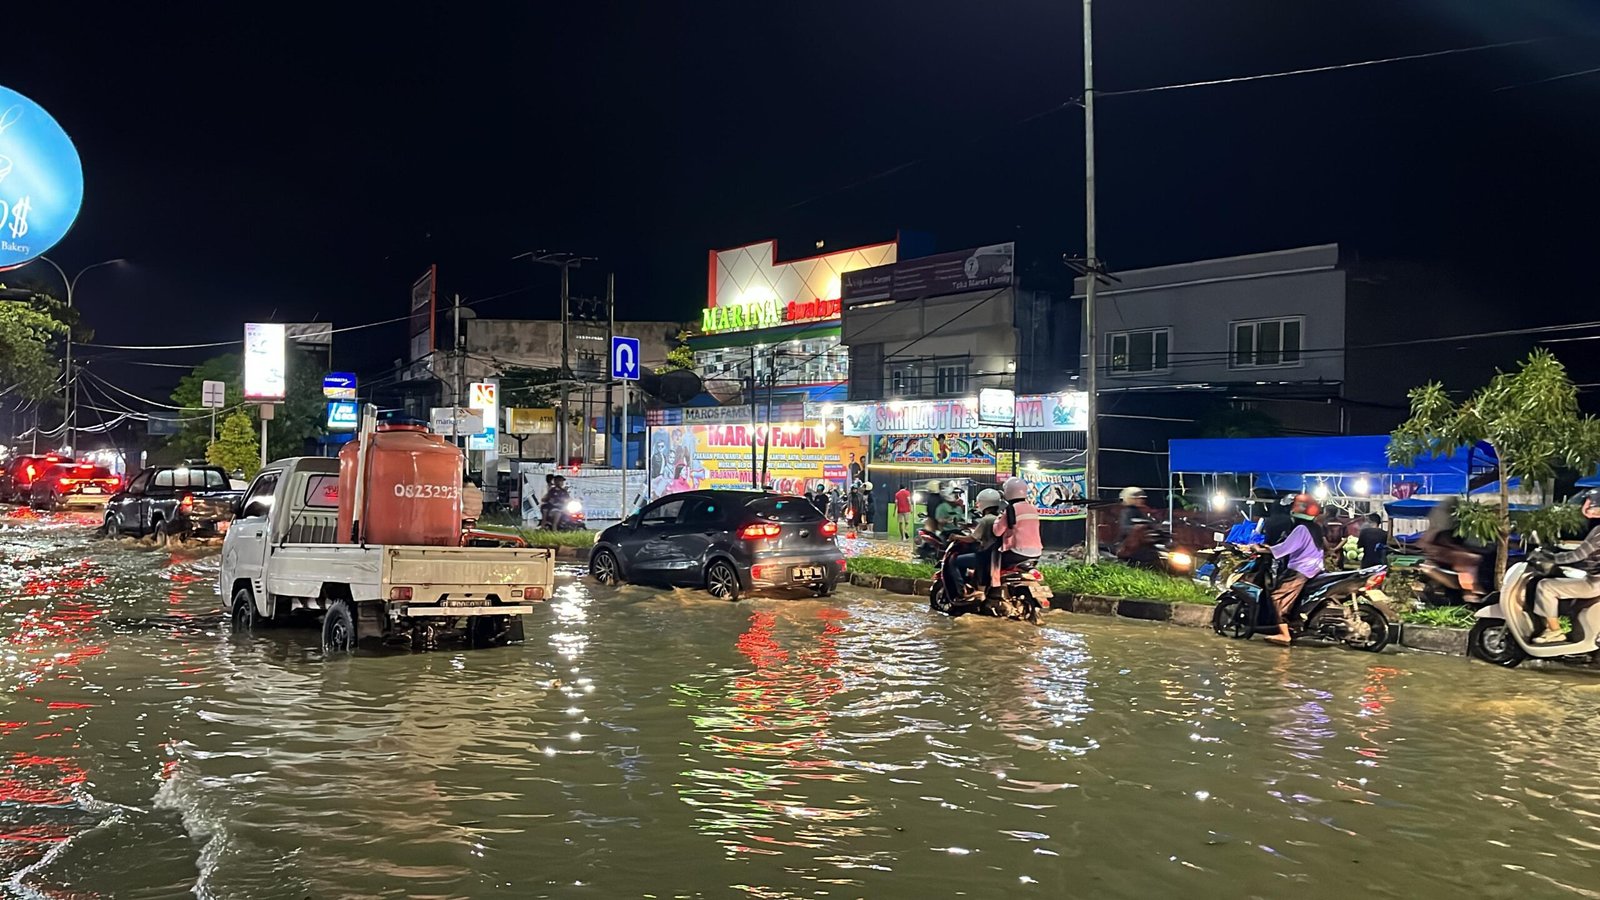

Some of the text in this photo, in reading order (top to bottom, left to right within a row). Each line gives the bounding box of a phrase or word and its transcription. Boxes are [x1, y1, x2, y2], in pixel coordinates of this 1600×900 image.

[1, 240, 30, 255] Bakery
[701, 300, 778, 331] MARINA
[685, 409, 719, 420] MAROS
[876, 406, 909, 431] SARI
[911, 404, 948, 430] LAUT
[1012, 400, 1044, 428] AYA
